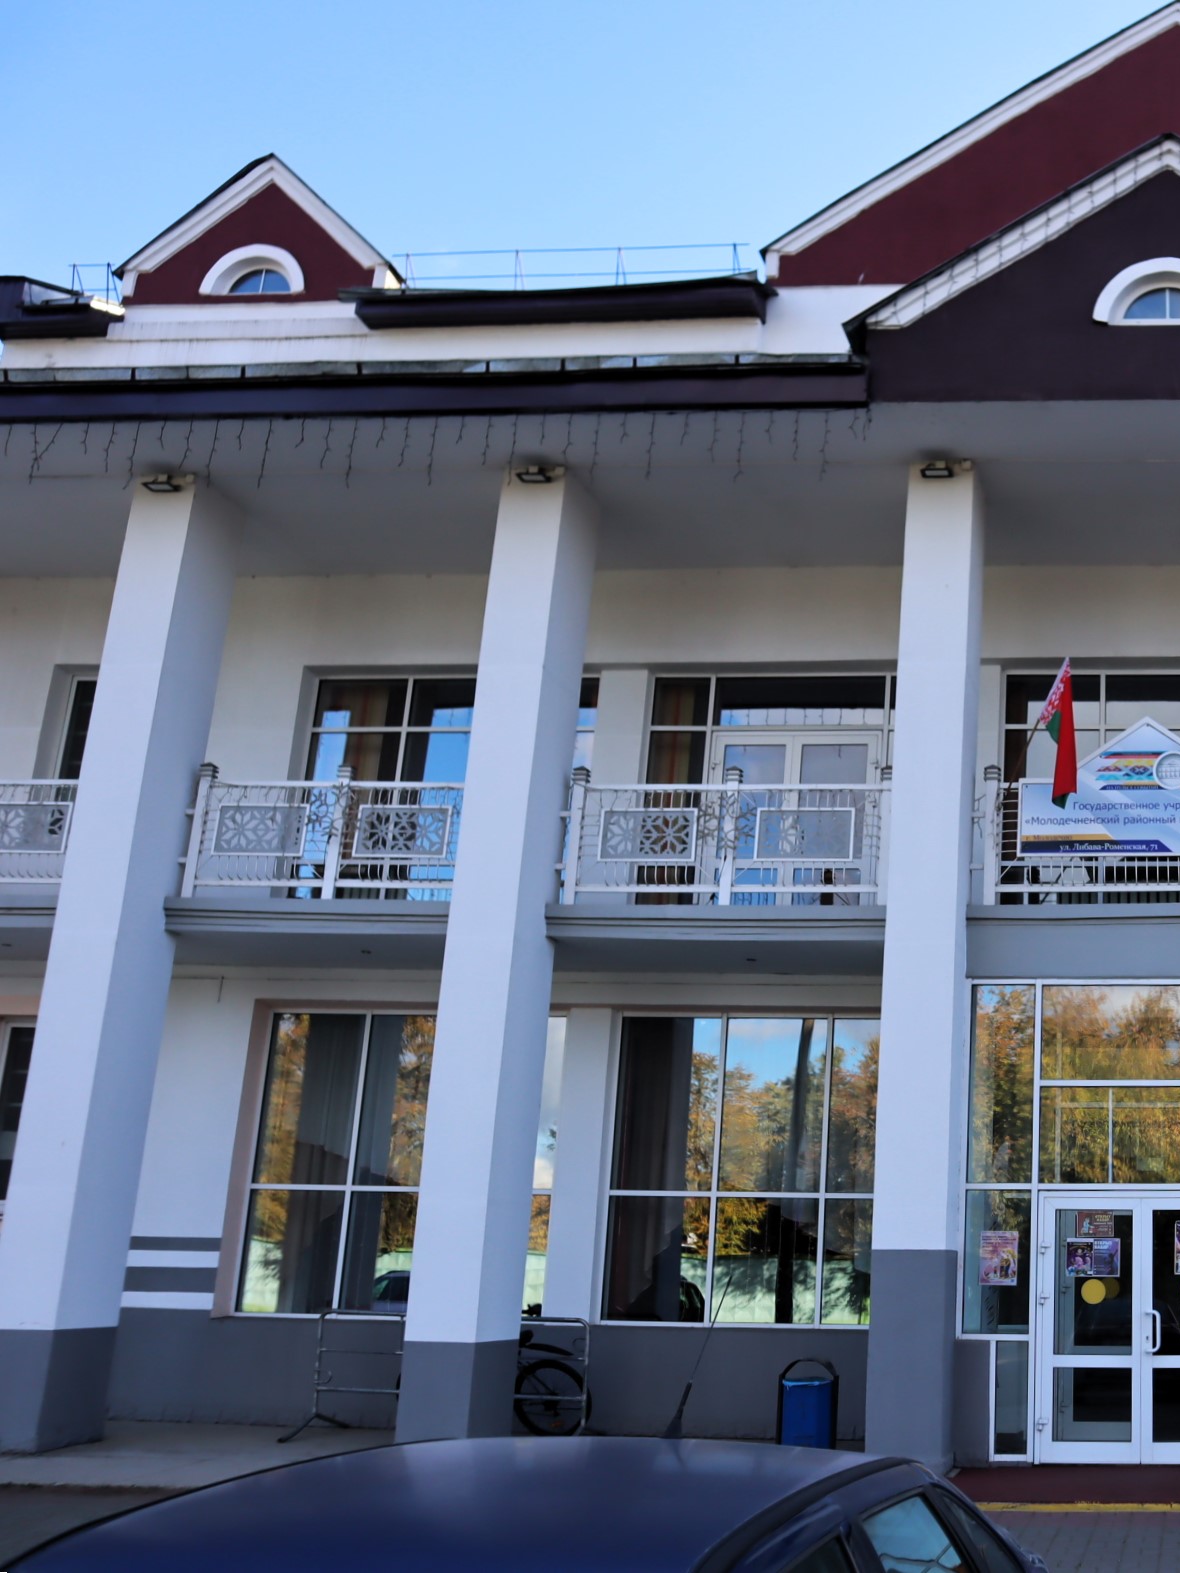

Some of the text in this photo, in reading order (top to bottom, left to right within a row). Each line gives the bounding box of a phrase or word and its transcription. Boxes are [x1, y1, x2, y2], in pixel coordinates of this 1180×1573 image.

[1072, 801, 1160, 812] Государственное
[1025, 815, 1120, 826] «Молодечненский
[1123, 814, 1176, 826] районный
[1059, 844, 1071, 853] ул.
